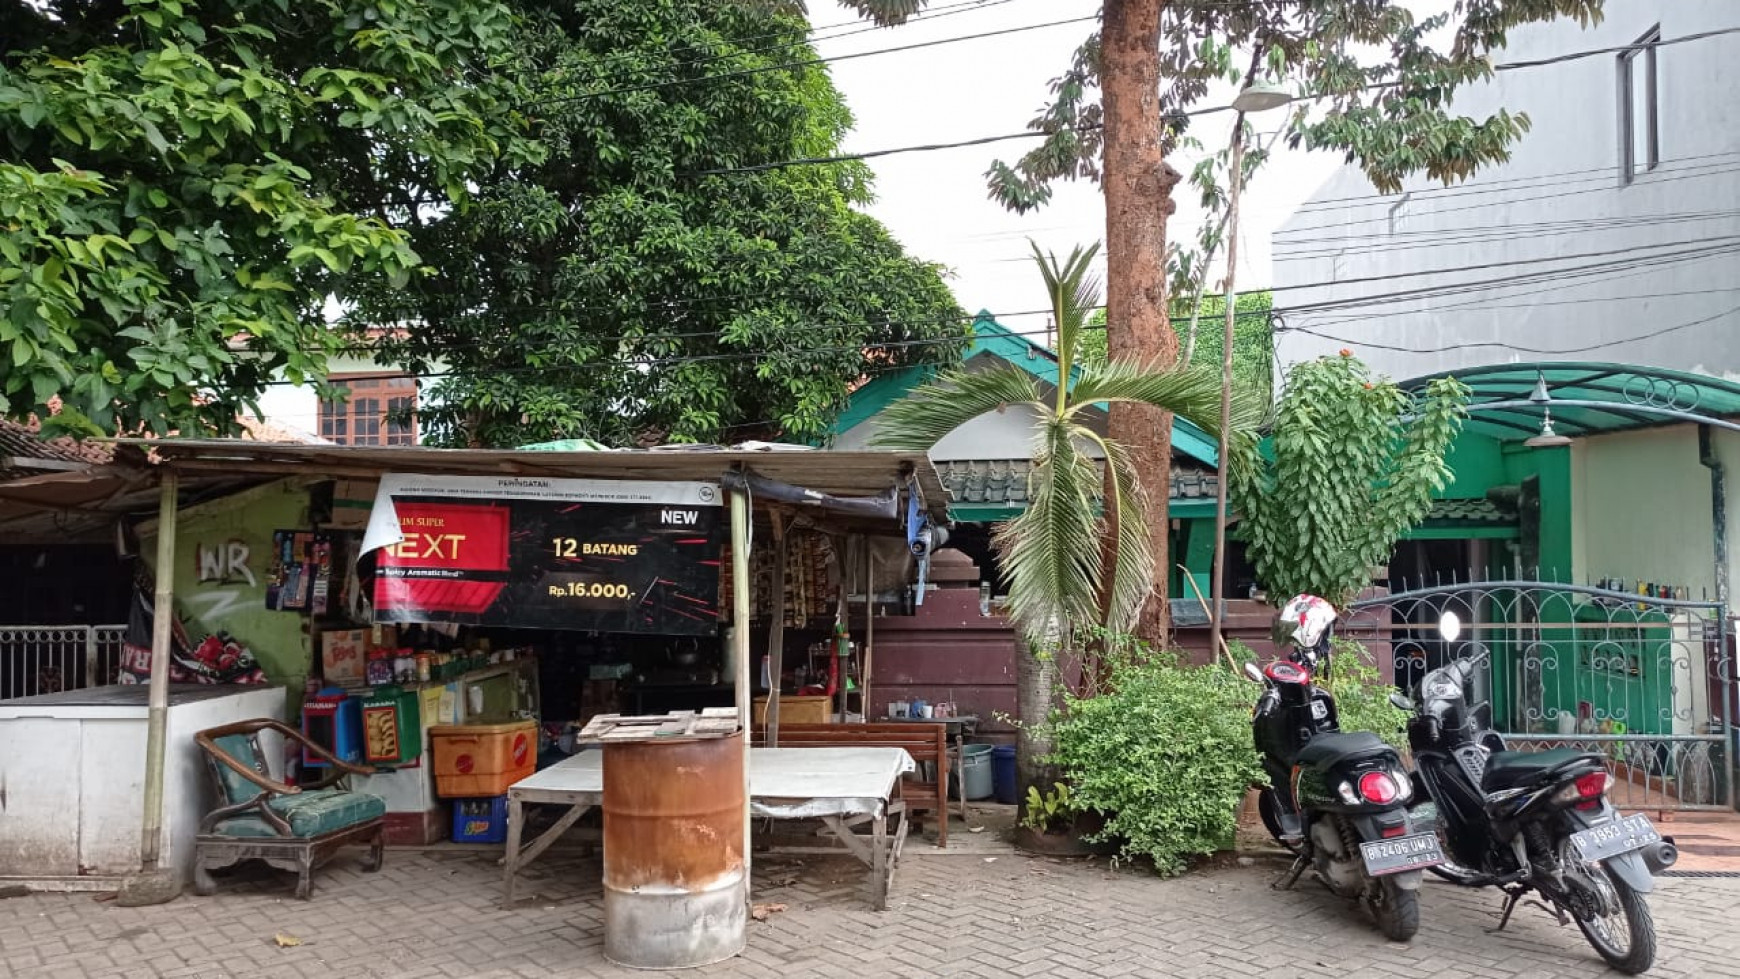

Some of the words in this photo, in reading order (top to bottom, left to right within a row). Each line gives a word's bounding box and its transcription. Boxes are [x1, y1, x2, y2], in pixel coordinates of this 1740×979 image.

[416, 517, 445, 527] SUPER
[661, 510, 699, 525] NEW
[552, 537, 578, 557] 12
[582, 543, 639, 556] BATANG
[407, 569, 441, 577] Aromatic
[548, 582, 637, 600] Rp.16.000,-
[1575, 836, 1587, 847] B
[1623, 817, 1650, 833] STA
[1367, 848, 1376, 860] B
[1380, 842, 1409, 857] 2406
